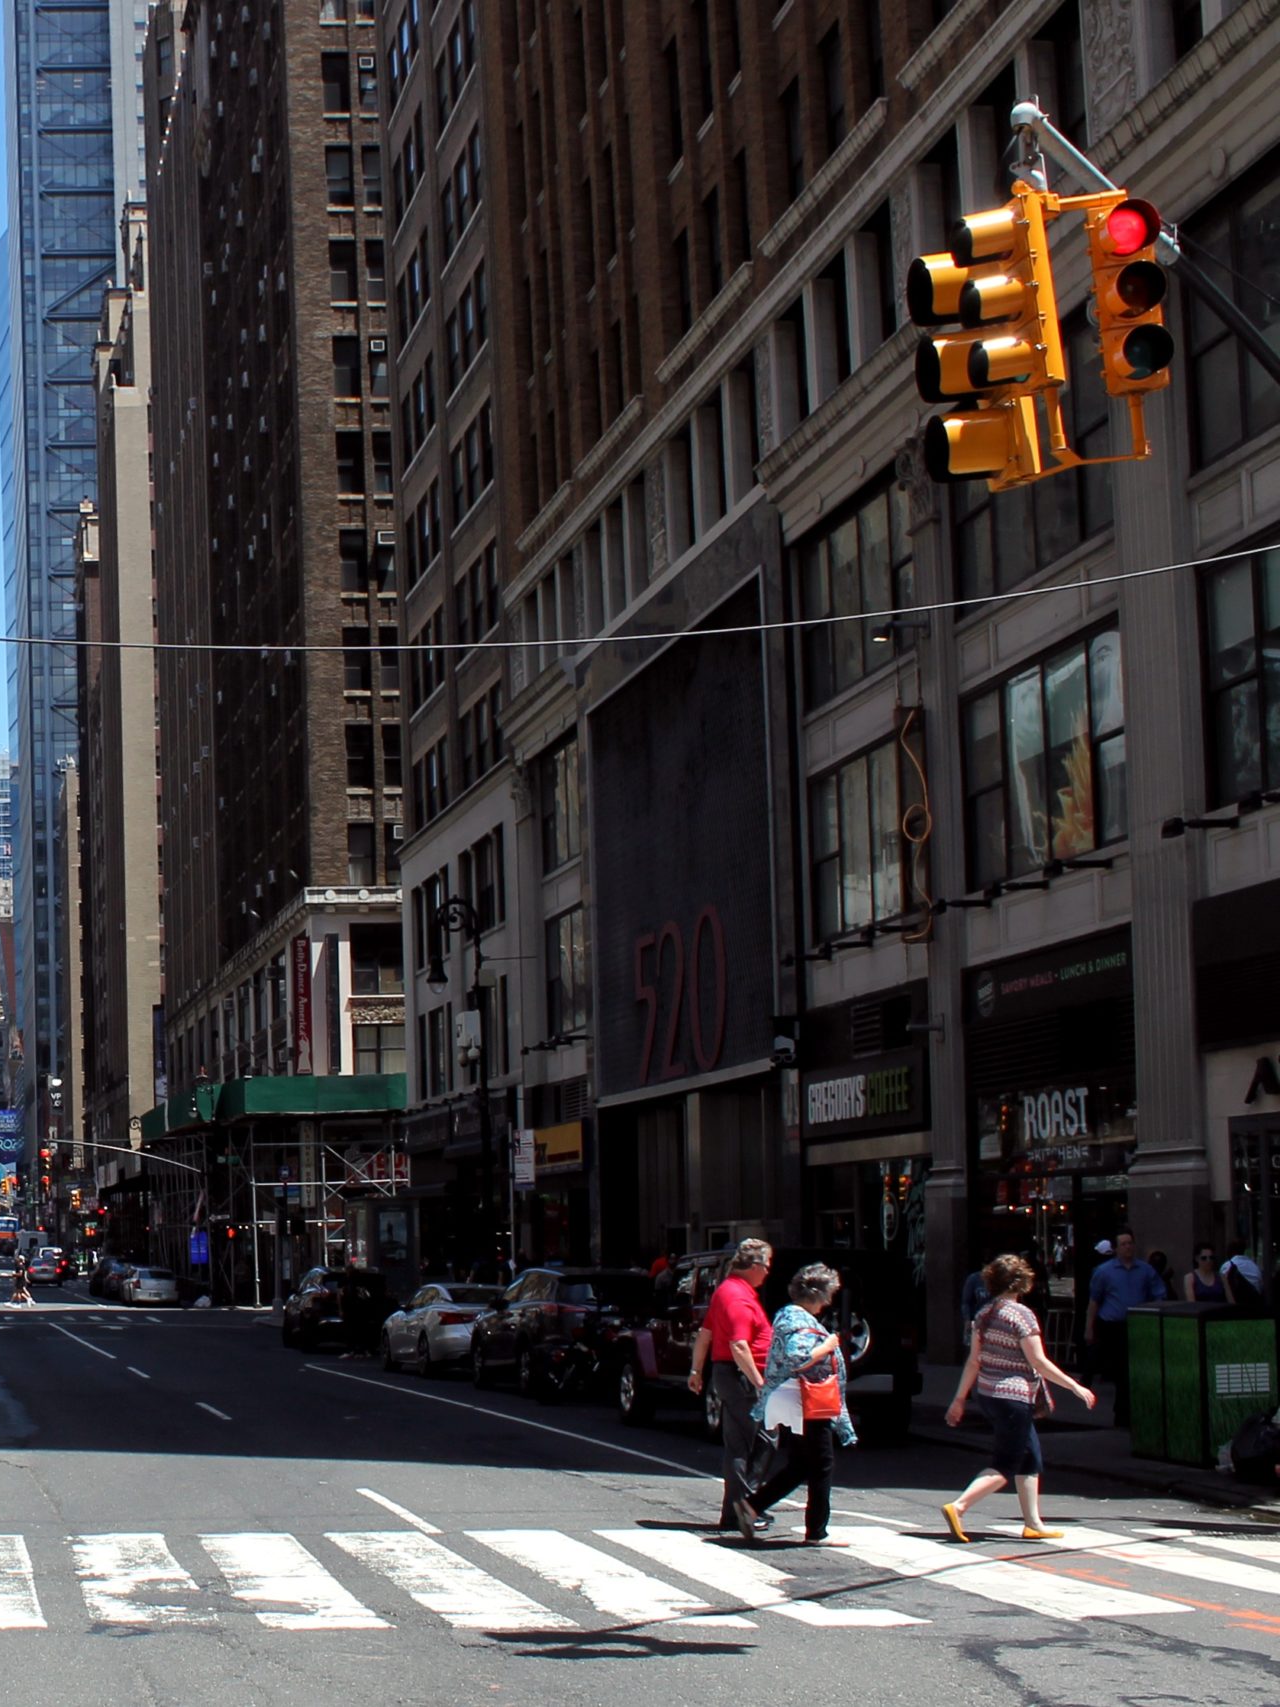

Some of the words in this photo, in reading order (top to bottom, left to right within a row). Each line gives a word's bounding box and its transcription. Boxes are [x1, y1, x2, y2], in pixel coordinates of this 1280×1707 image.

[633, 904, 727, 1085] 520
[1059, 961, 1087, 981] LUNCH
[1095, 951, 1128, 972] DINNER
[808, 1074, 865, 1125] GREGORYS
[866, 1064, 911, 1116] COFFEE
[1023, 1086, 1089, 1142] ROAST
